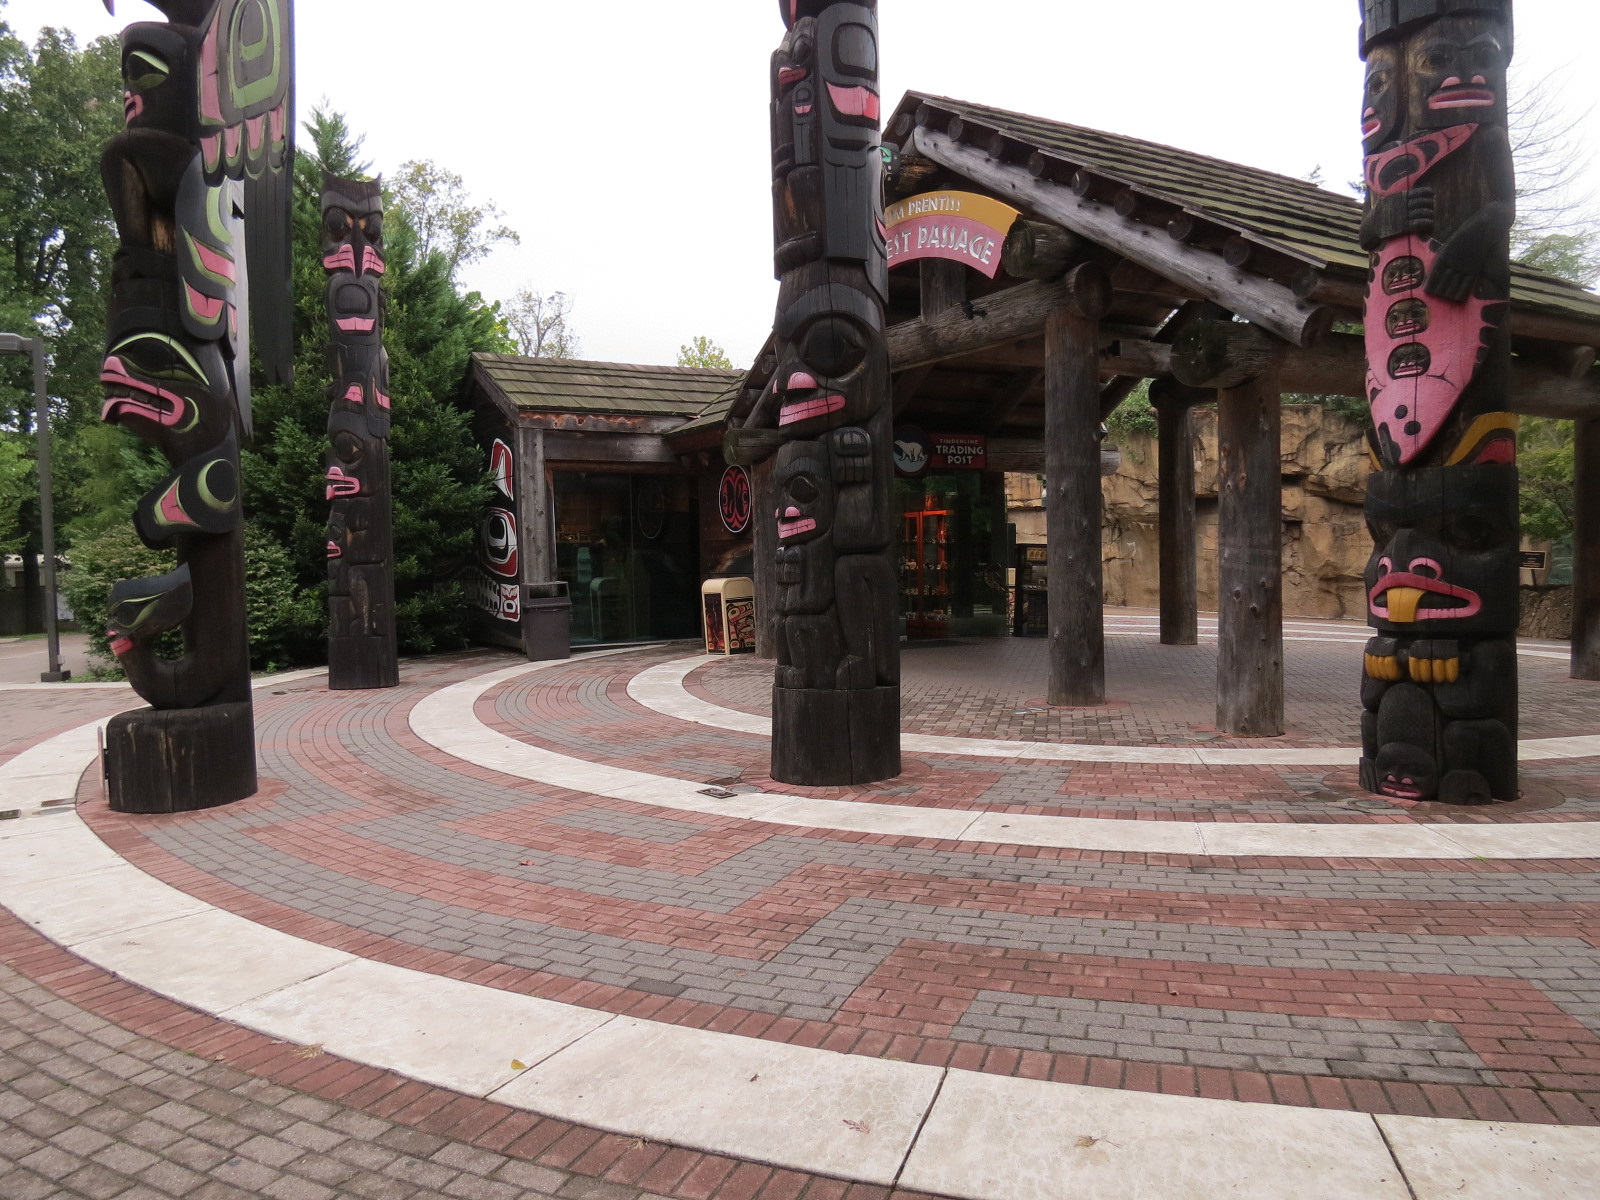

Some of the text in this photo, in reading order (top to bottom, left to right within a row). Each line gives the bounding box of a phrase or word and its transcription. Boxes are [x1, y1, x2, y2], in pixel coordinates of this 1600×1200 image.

[917, 224, 995, 265] PASSAGE
[936, 445, 984, 455] TRADING
[947, 455, 973, 464] POST
